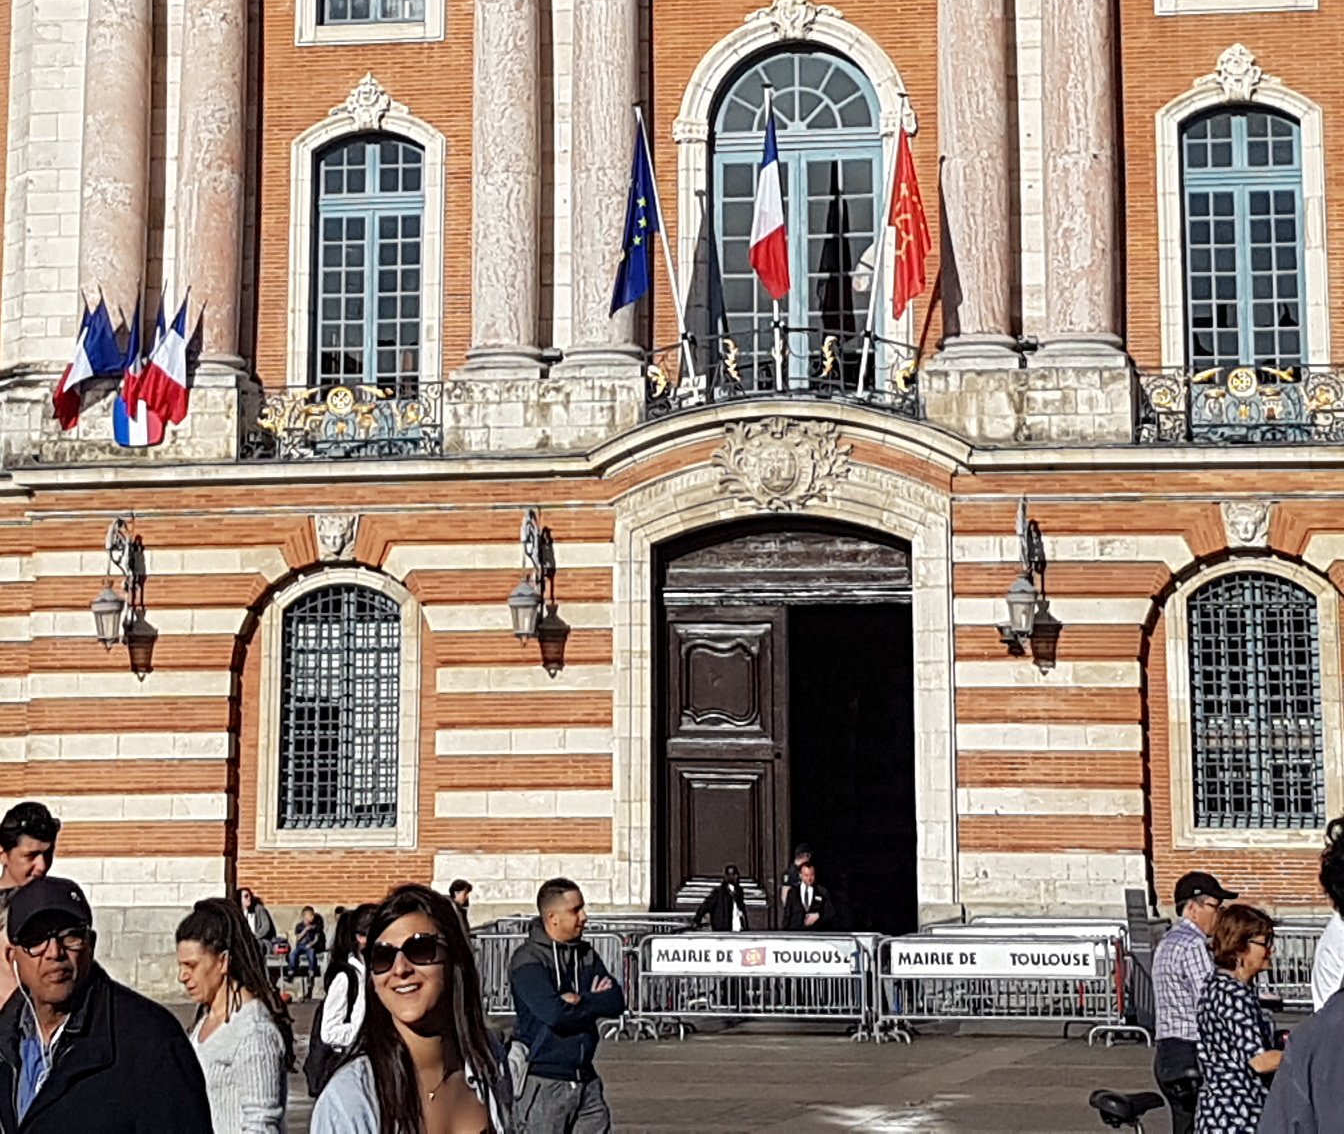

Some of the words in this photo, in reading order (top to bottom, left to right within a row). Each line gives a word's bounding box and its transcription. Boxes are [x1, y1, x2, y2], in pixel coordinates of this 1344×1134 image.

[656, 949, 711, 963] MAIRIE
[716, 949, 734, 963] DE
[898, 952, 954, 965] MAIRIE
[959, 953, 977, 965] DE
[1010, 952, 1090, 966] TOULOUSE
